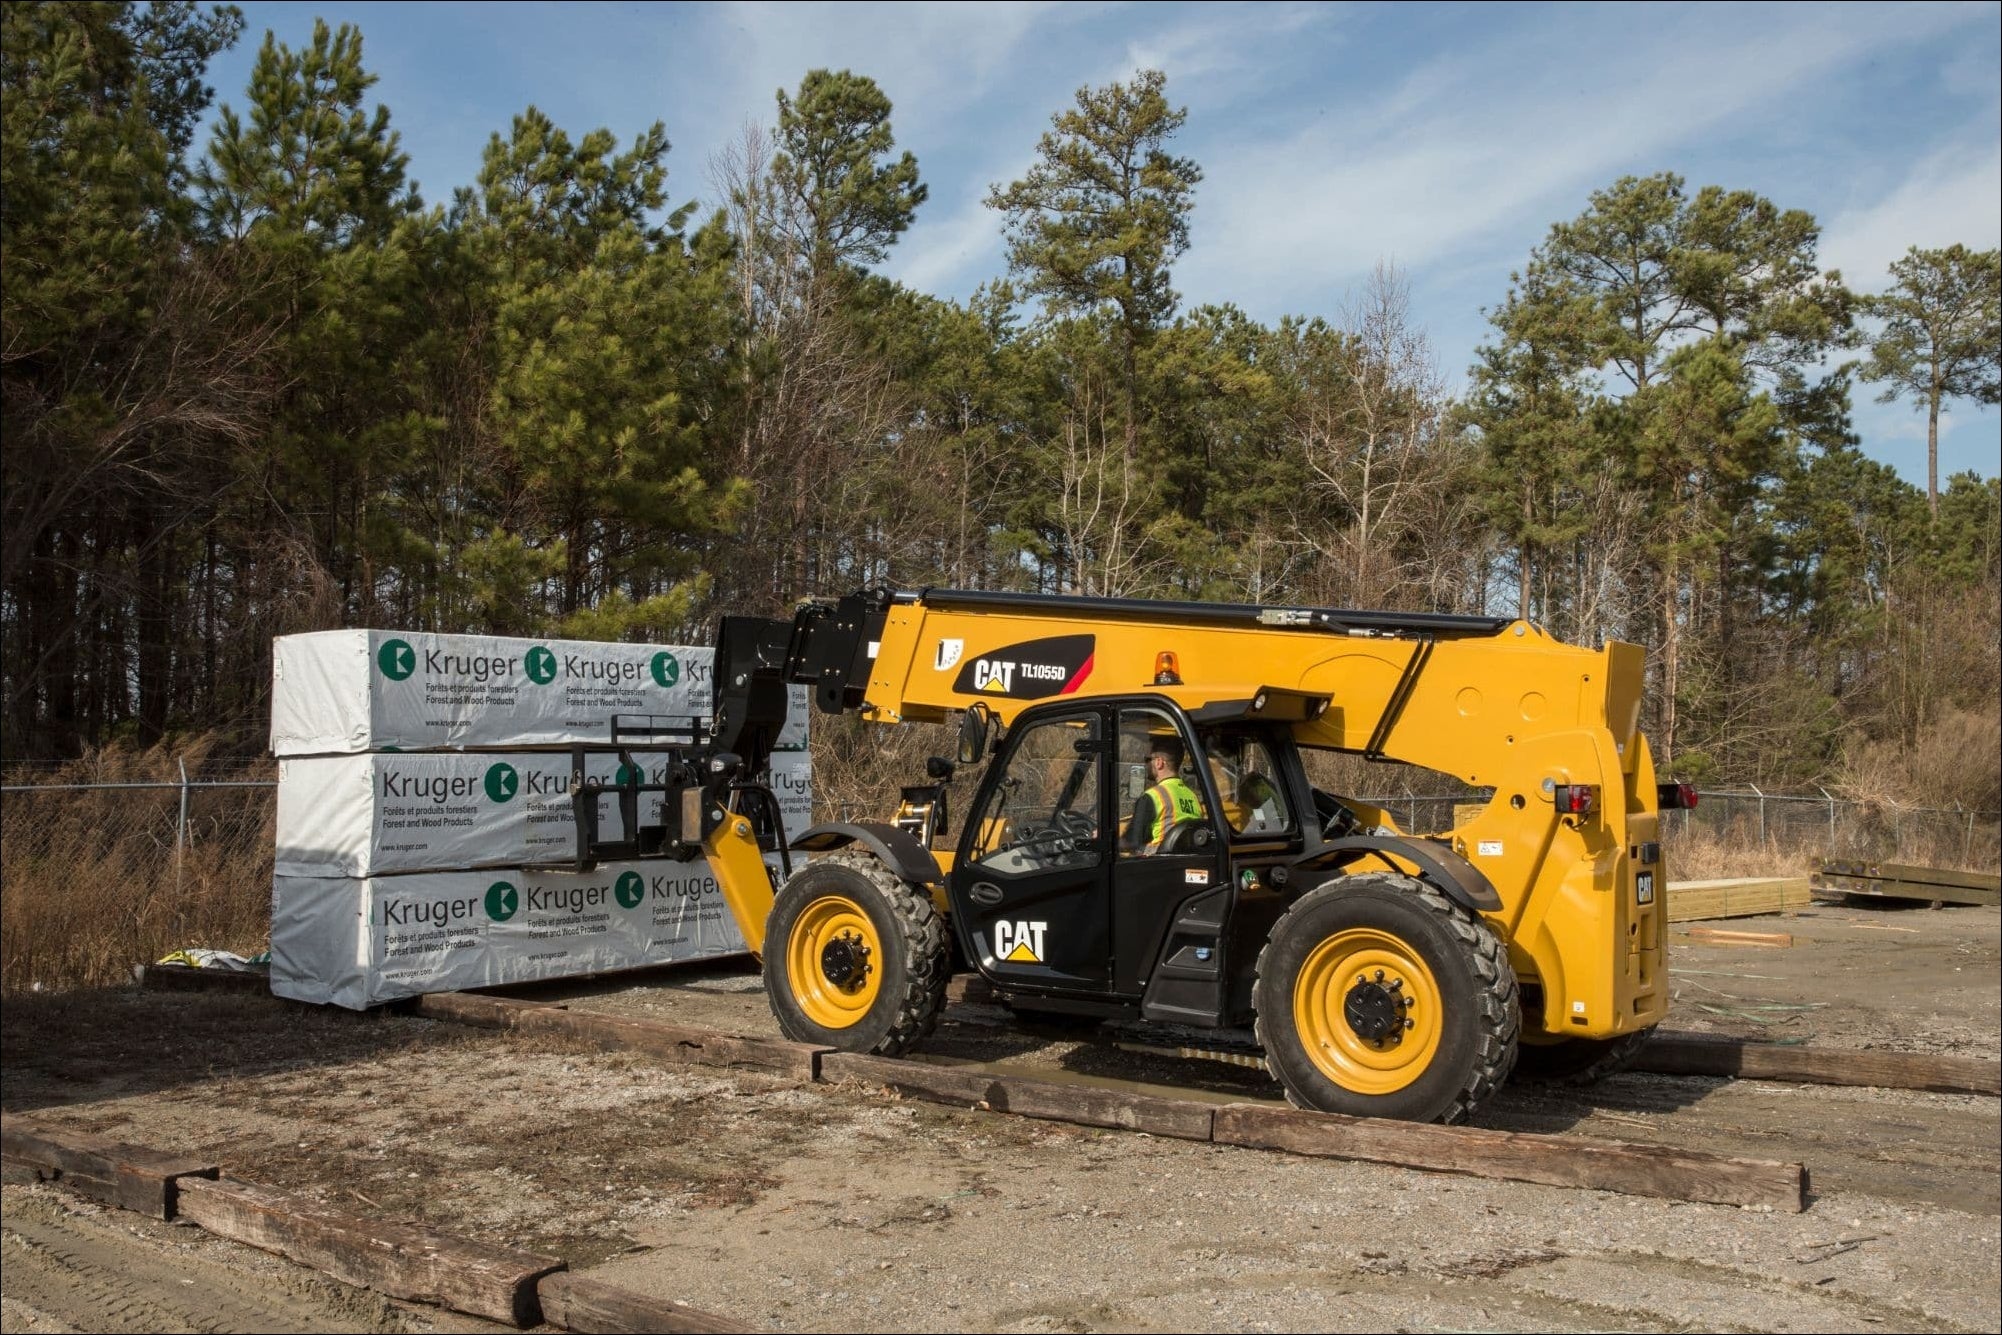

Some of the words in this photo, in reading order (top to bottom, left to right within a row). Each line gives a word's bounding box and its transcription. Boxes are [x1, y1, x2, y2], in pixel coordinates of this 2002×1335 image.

[425, 649, 517, 682] Kruger
[564, 655, 644, 686] Kruger
[974, 659, 1016, 693] CAT
[1021, 663, 1066, 681] TL1055D
[425, 683, 448, 692] Forêts
[450, 684, 456, 692] et
[457, 684, 486, 693] produits
[425, 695, 450, 704] Forest
[464, 696, 483, 704] Wood
[486, 696, 515, 705] Products
[566, 697, 587, 706] Forest
[587, 698, 599, 706] and
[600, 698, 616, 706] Wood
[617, 699, 643, 707] Products
[383, 772, 478, 803] Kruger
[383, 807, 405, 816] Forêts
[407, 807, 414, 815] et
[416, 806, 445, 817] produits
[446, 805, 477, 814] forestiers
[560, 814, 575, 822] Woo
[383, 819, 405, 828] Forest
[406, 819, 420, 827] and
[421, 818, 442, 827] Wood
[443, 817, 474, 826] Products
[381, 843, 428, 852] www.kruger.com
[1638, 876, 1652, 902] CAT
[527, 886, 609, 913] Kruger
[384, 898, 478, 928] Kruger
[528, 919, 547, 928] Forêts
[556, 915, 580, 927] produits
[384, 935, 407, 944] Forêts
[409, 934, 417, 942] et
[418, 930, 446, 941] produits
[447, 927, 479, 936] forestiers
[528, 931, 549, 939] Forest
[549, 929, 561, 938] and
[562, 927, 579, 936] Wood
[580, 925, 607, 934] Products
[384, 948, 409, 957] Forest
[410, 945, 423, 954] and
[424, 943, 444, 952] Wood
[445, 939, 476, 949] Products
[994, 919, 1047, 962] CAT
[385, 968, 433, 979] www.kruger.com
